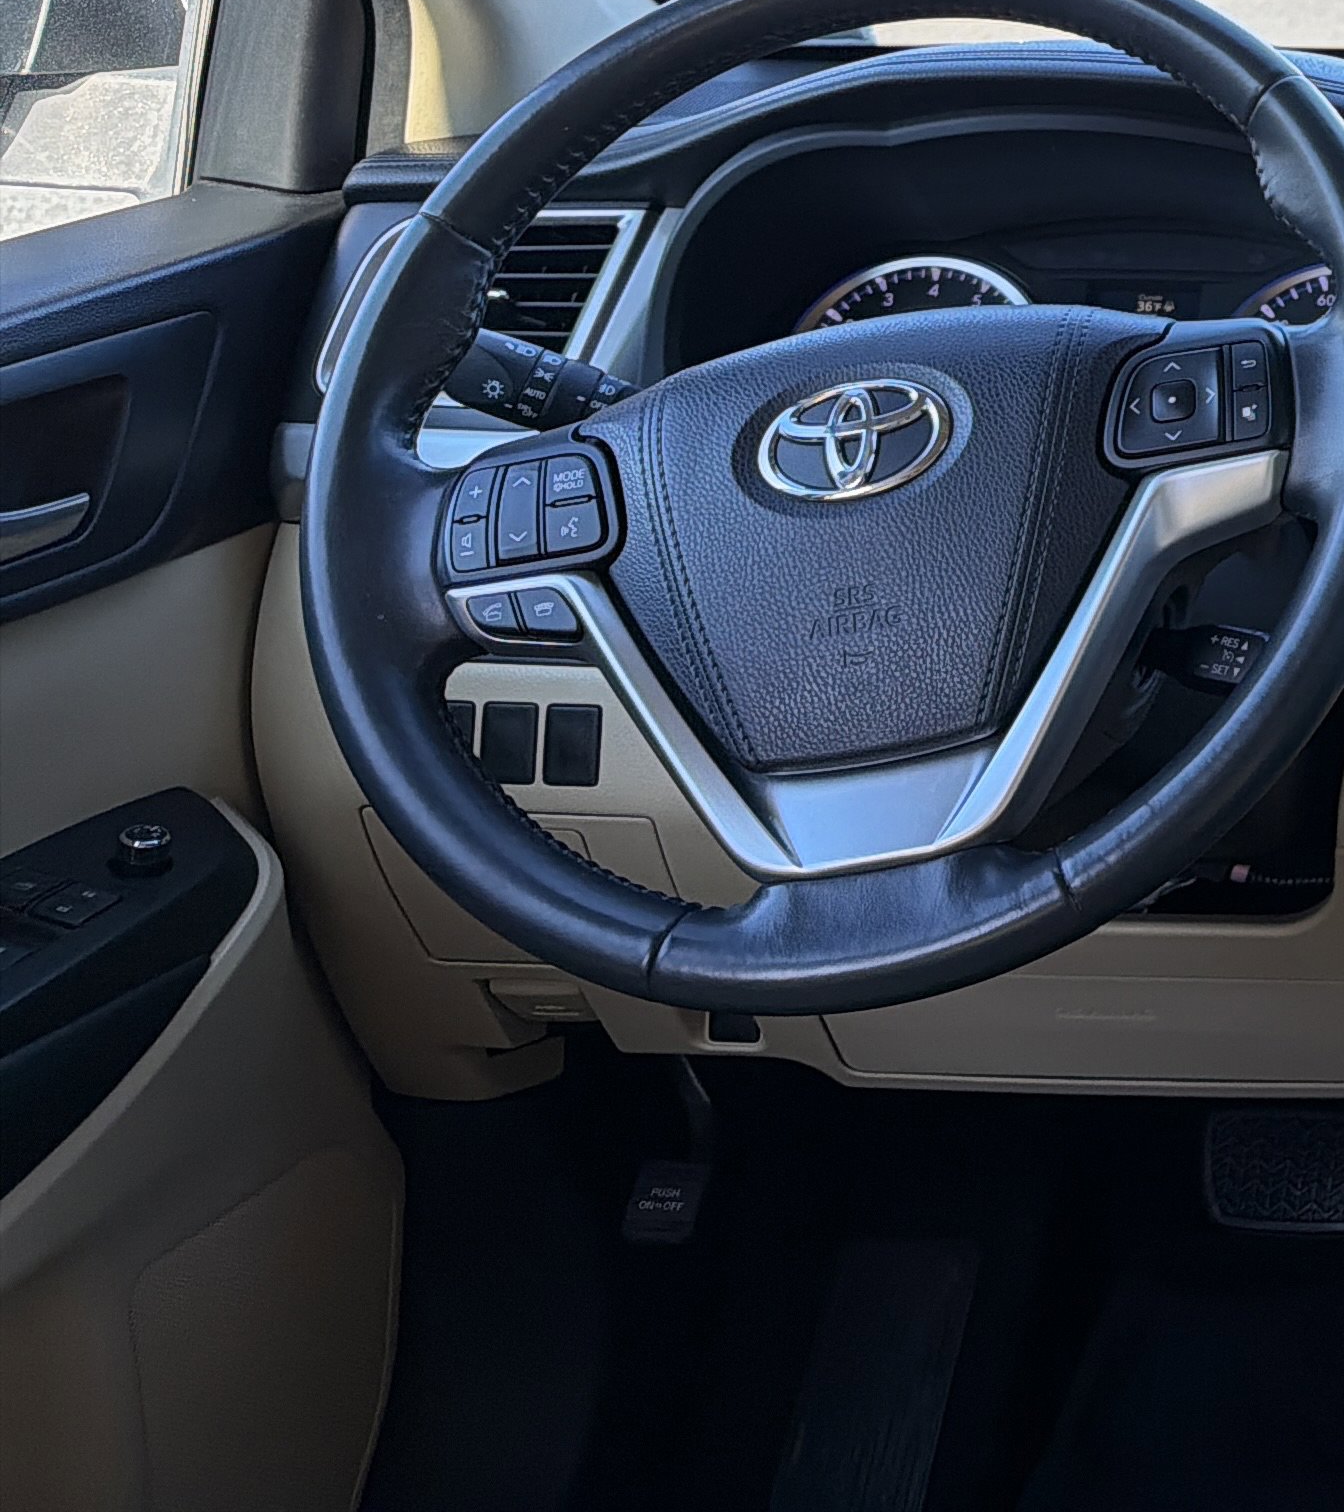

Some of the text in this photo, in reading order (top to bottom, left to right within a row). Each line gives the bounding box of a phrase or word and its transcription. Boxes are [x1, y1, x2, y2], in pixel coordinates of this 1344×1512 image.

[928, 284, 940, 297] 4
[883, 293, 894, 307] 3
[1316, 294, 1337, 307] 60
[523, 388, 546, 400] AUTO
[553, 468, 586, 482] MODE
[560, 480, 583, 489] HOLD
[834, 583, 875, 606] SRS
[809, 605, 903, 640] AIRBAG
[1220, 636, 1240, 648] RES
[1211, 664, 1230, 675] SET
[651, 1188, 680, 1197] PUSH
[663, 1201, 685, 1211] OFF
